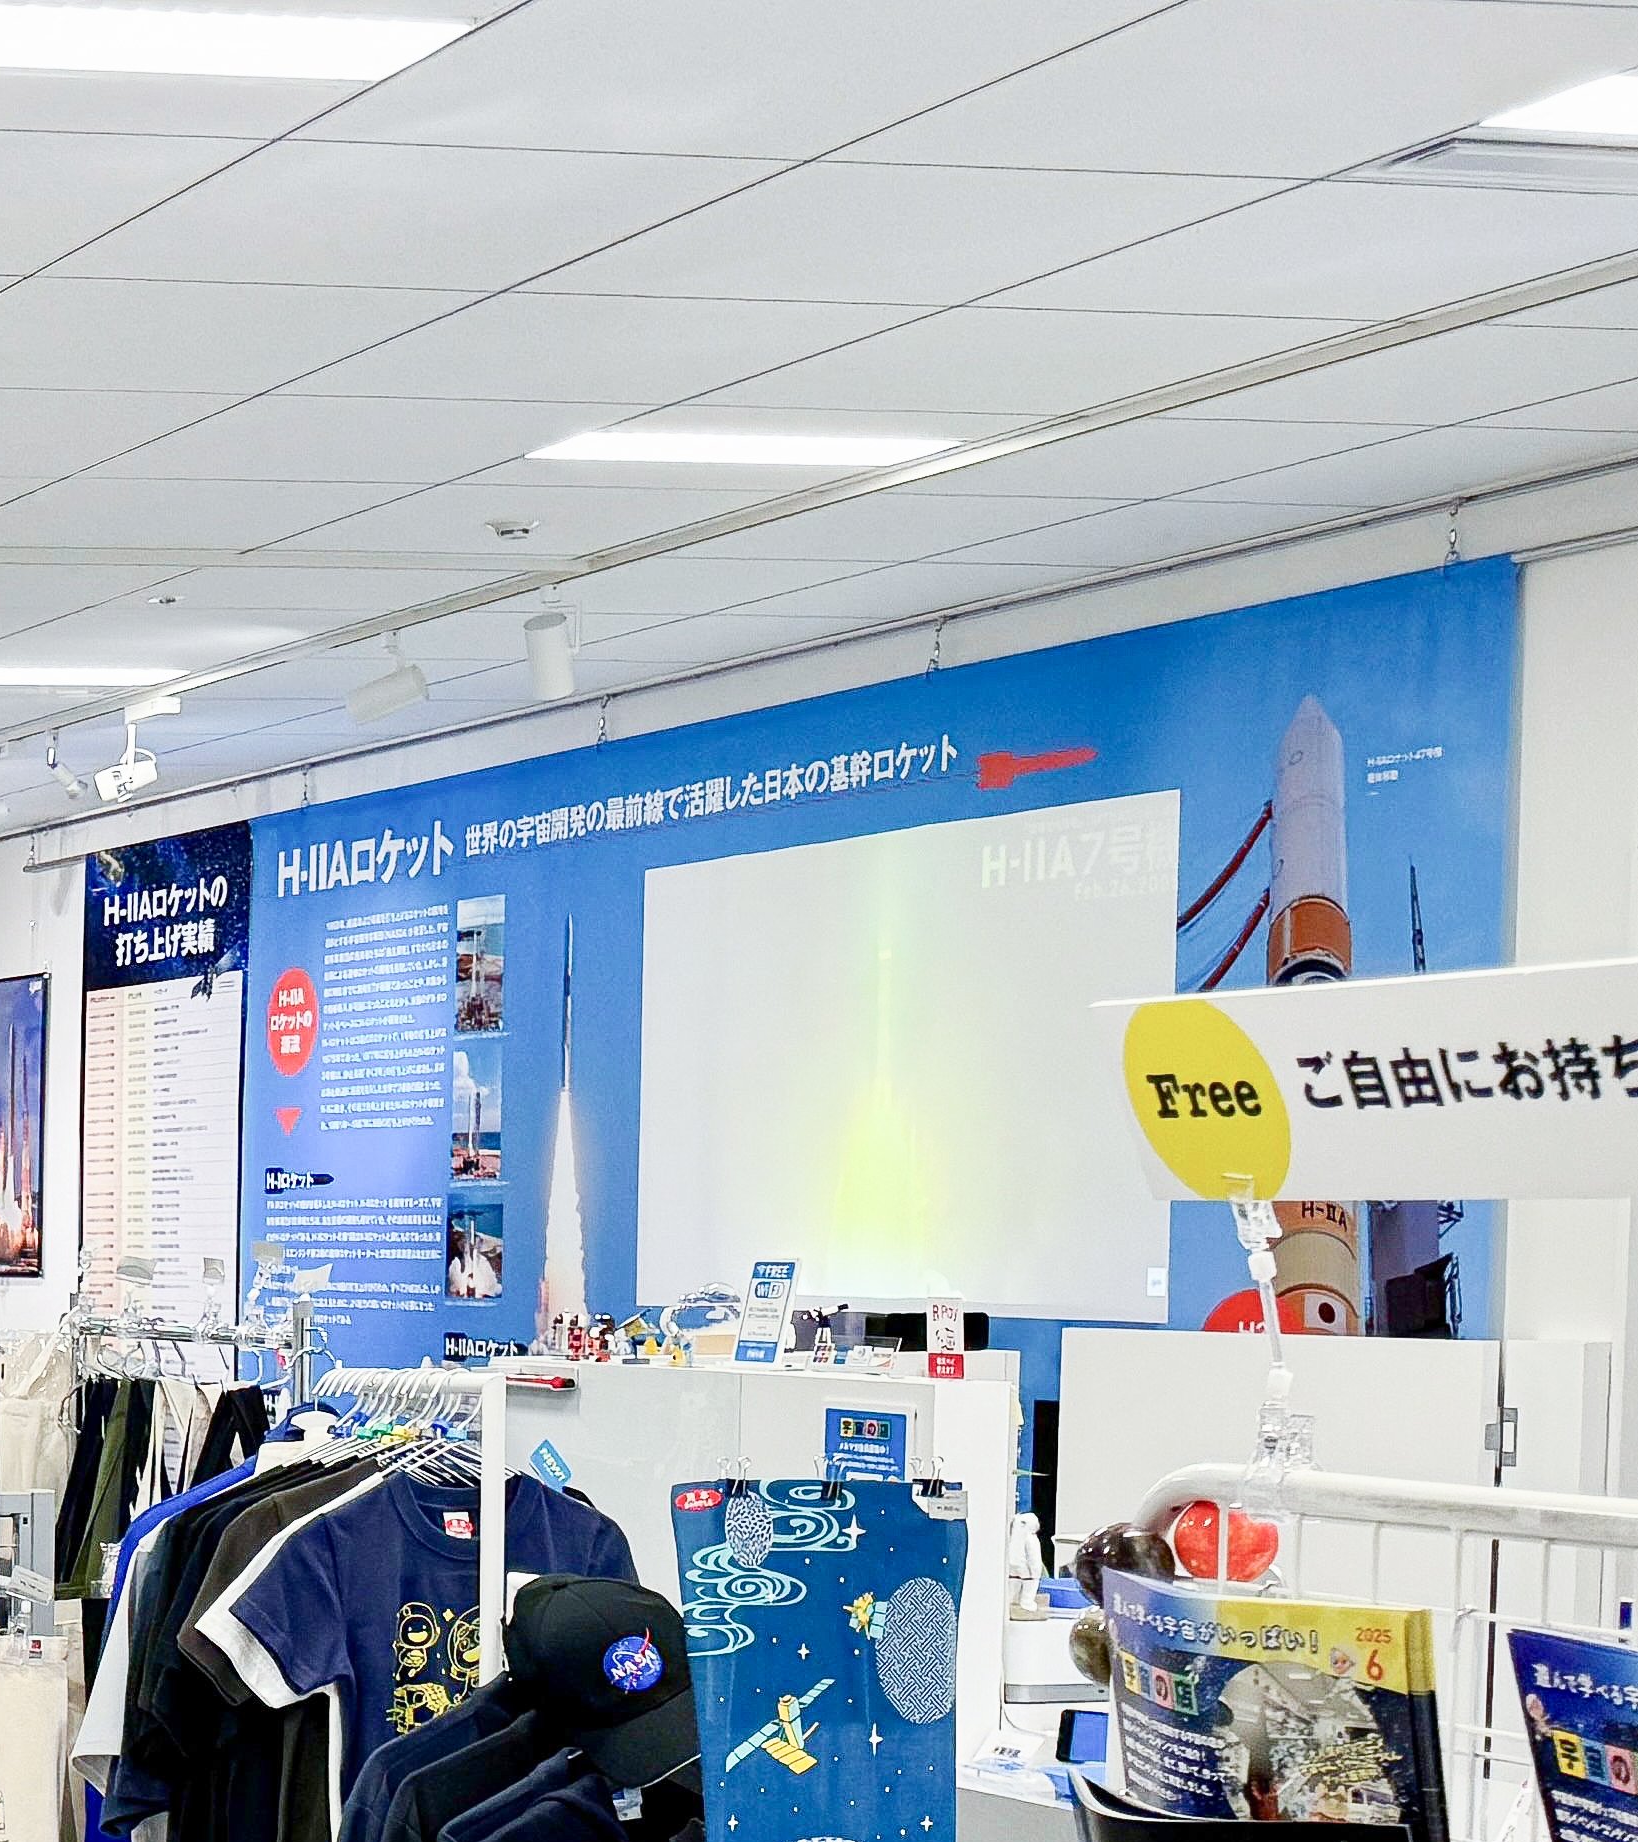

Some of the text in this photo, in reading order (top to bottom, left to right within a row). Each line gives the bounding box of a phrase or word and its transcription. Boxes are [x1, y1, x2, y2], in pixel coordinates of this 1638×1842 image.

[466, 734, 958, 857] 世界の宇宙開発の最前線で活躍した日本の基幹ロケット
[278, 822, 455, 897] H-IIAロケット
[104, 875, 228, 926] H-IIAロケットの
[116, 918, 215, 968] 打ち上げ実績
[1146, 1072, 1263, 1120] Free
[1355, 1626, 1392, 1643] 2025
[1366, 1650, 1384, 1682] 6
